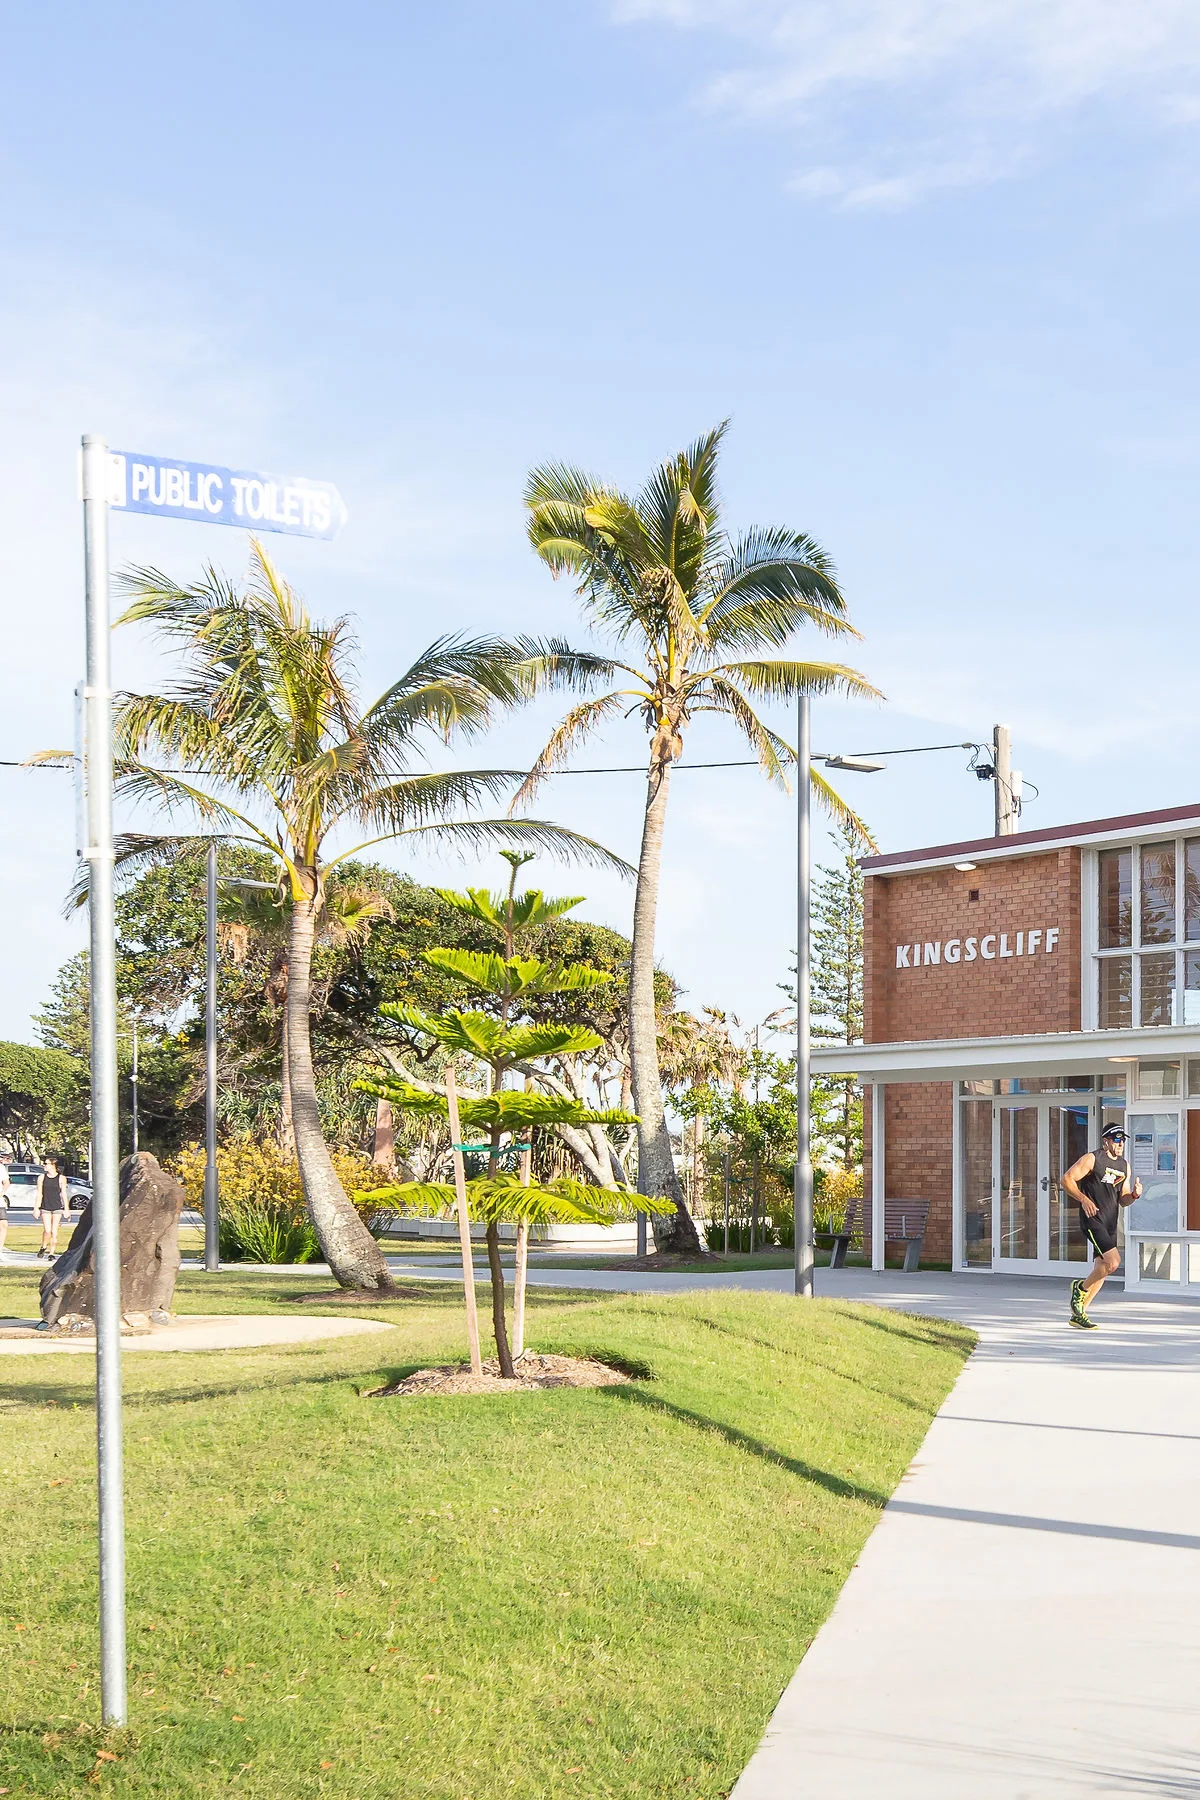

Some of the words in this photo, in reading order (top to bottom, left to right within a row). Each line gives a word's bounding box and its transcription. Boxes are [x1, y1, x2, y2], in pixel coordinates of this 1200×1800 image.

[131, 463, 223, 514] PUBLIC
[230, 476, 332, 532] TOILETS
[895, 927, 1060, 969] KINGSCLIFF
